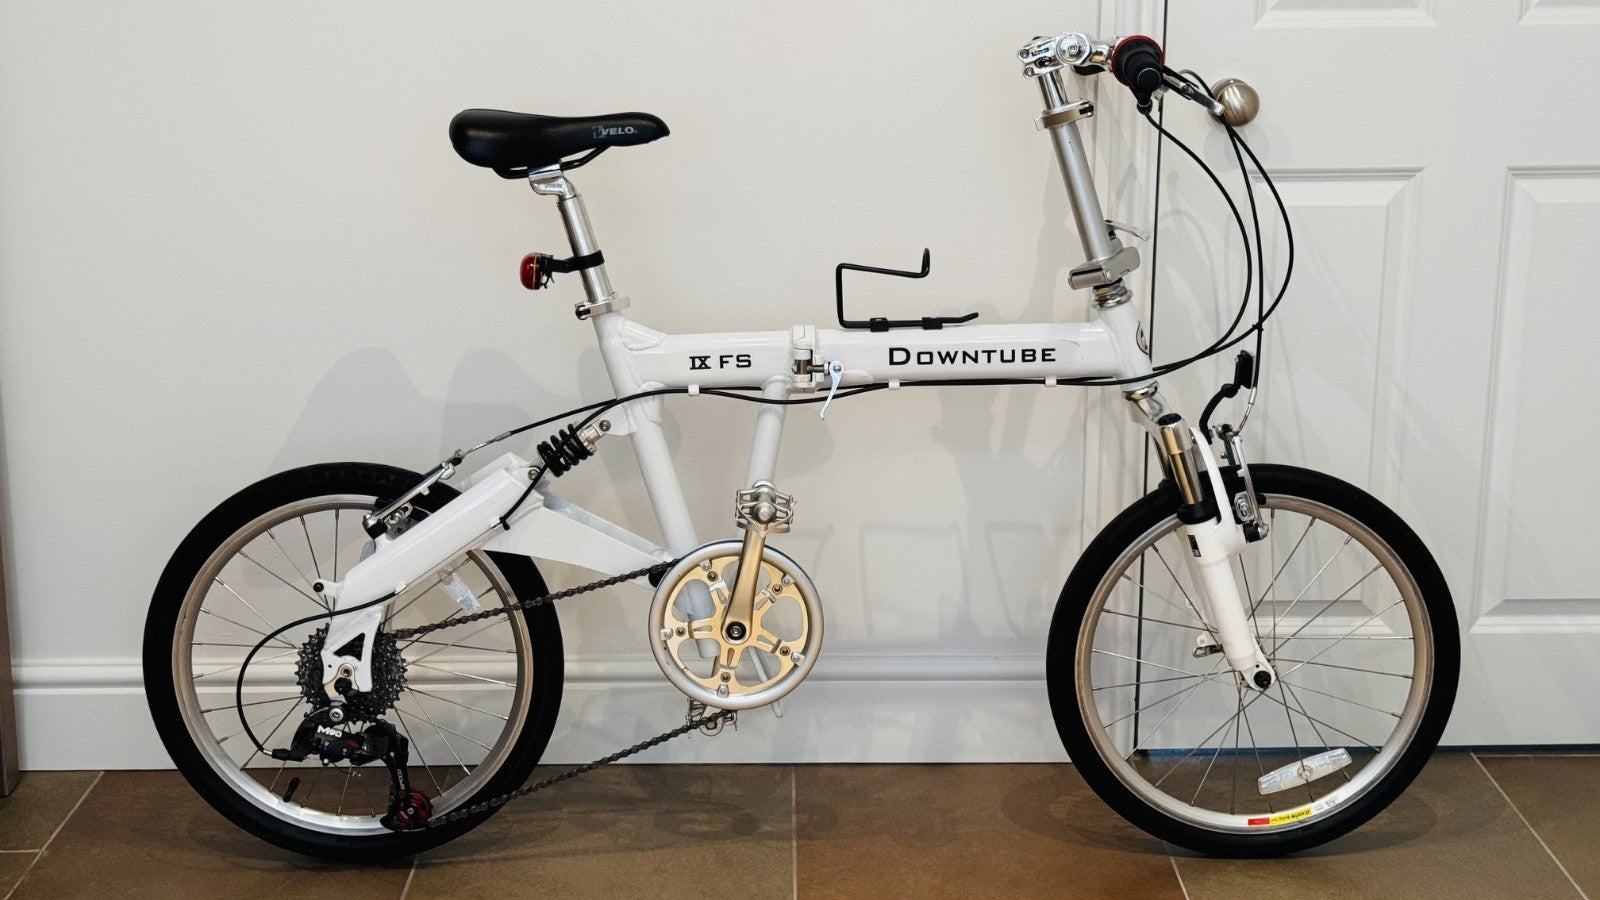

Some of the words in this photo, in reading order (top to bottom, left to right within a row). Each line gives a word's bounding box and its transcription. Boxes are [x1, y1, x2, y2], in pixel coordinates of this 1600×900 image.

[689, 355, 711, 370] IX
[719, 353, 752, 369] FS
[888, 347, 1056, 366] DOWNTUBE
